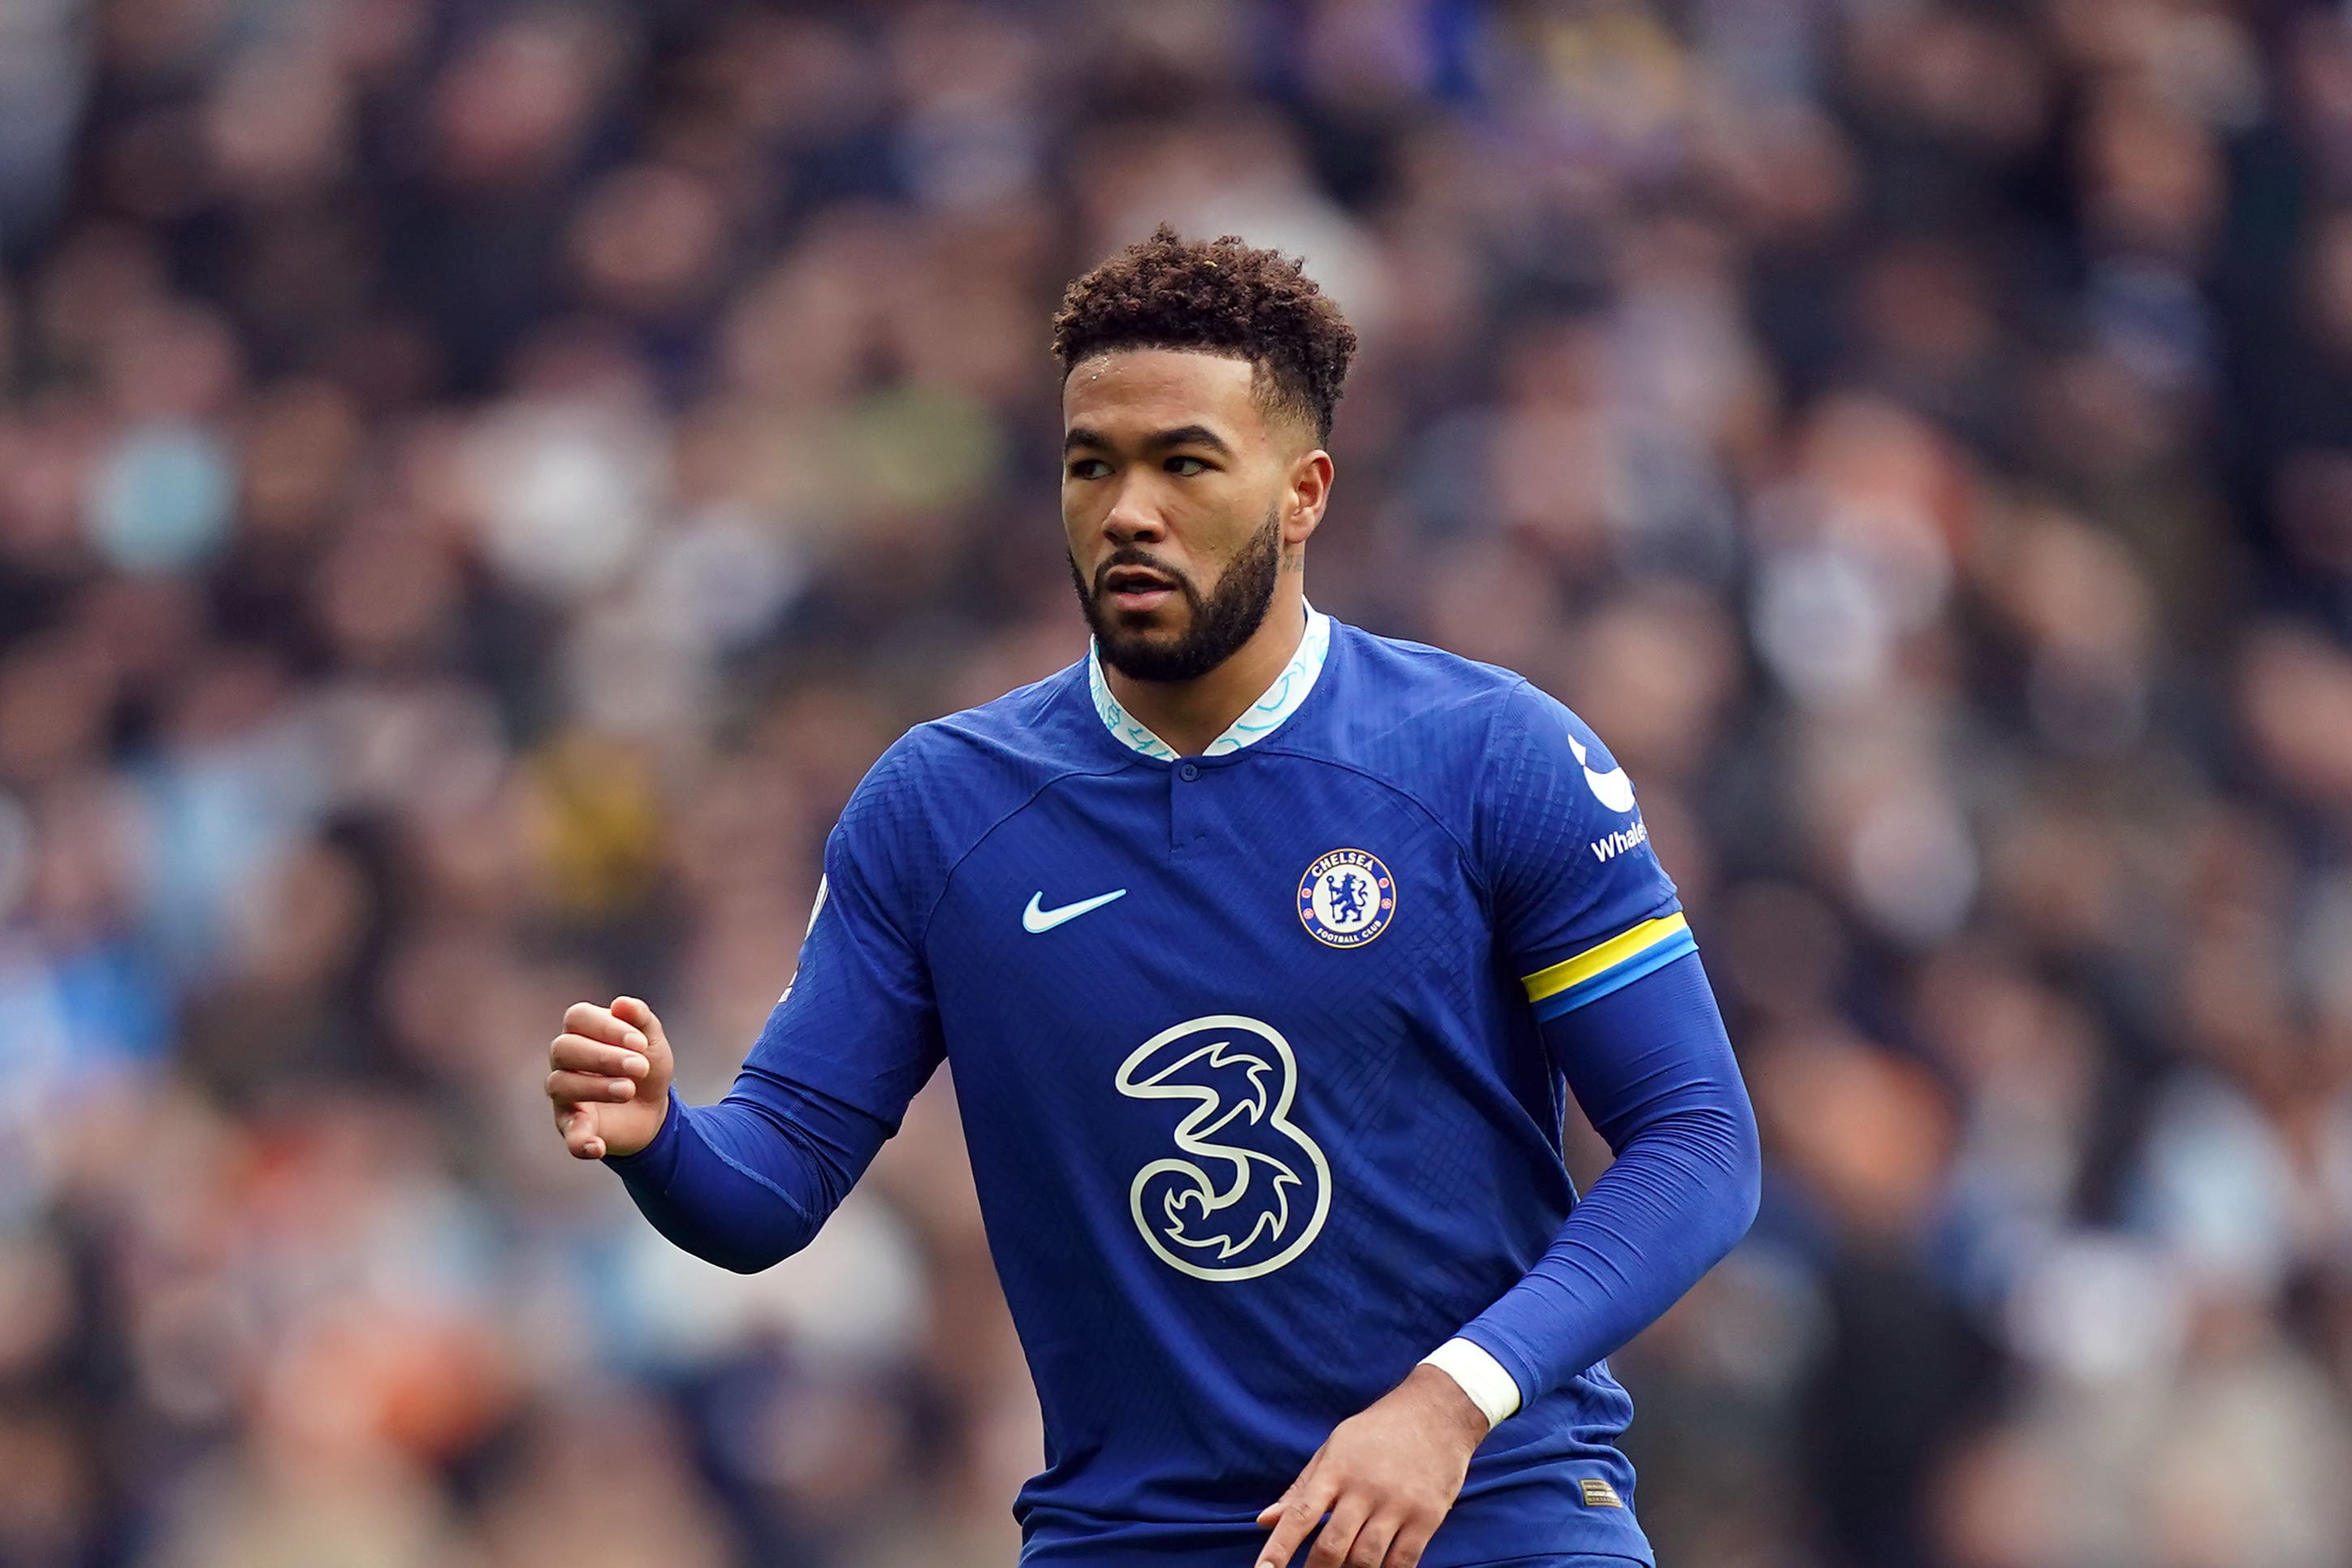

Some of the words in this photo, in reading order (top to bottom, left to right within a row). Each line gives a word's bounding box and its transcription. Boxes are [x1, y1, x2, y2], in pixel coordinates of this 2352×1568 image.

[1590, 822, 1647, 862] Whale
[1311, 853, 1373, 877] CHELSEA
[1316, 927, 1360, 943] FOOTBALL
[1361, 920, 1382, 938] CLUB
